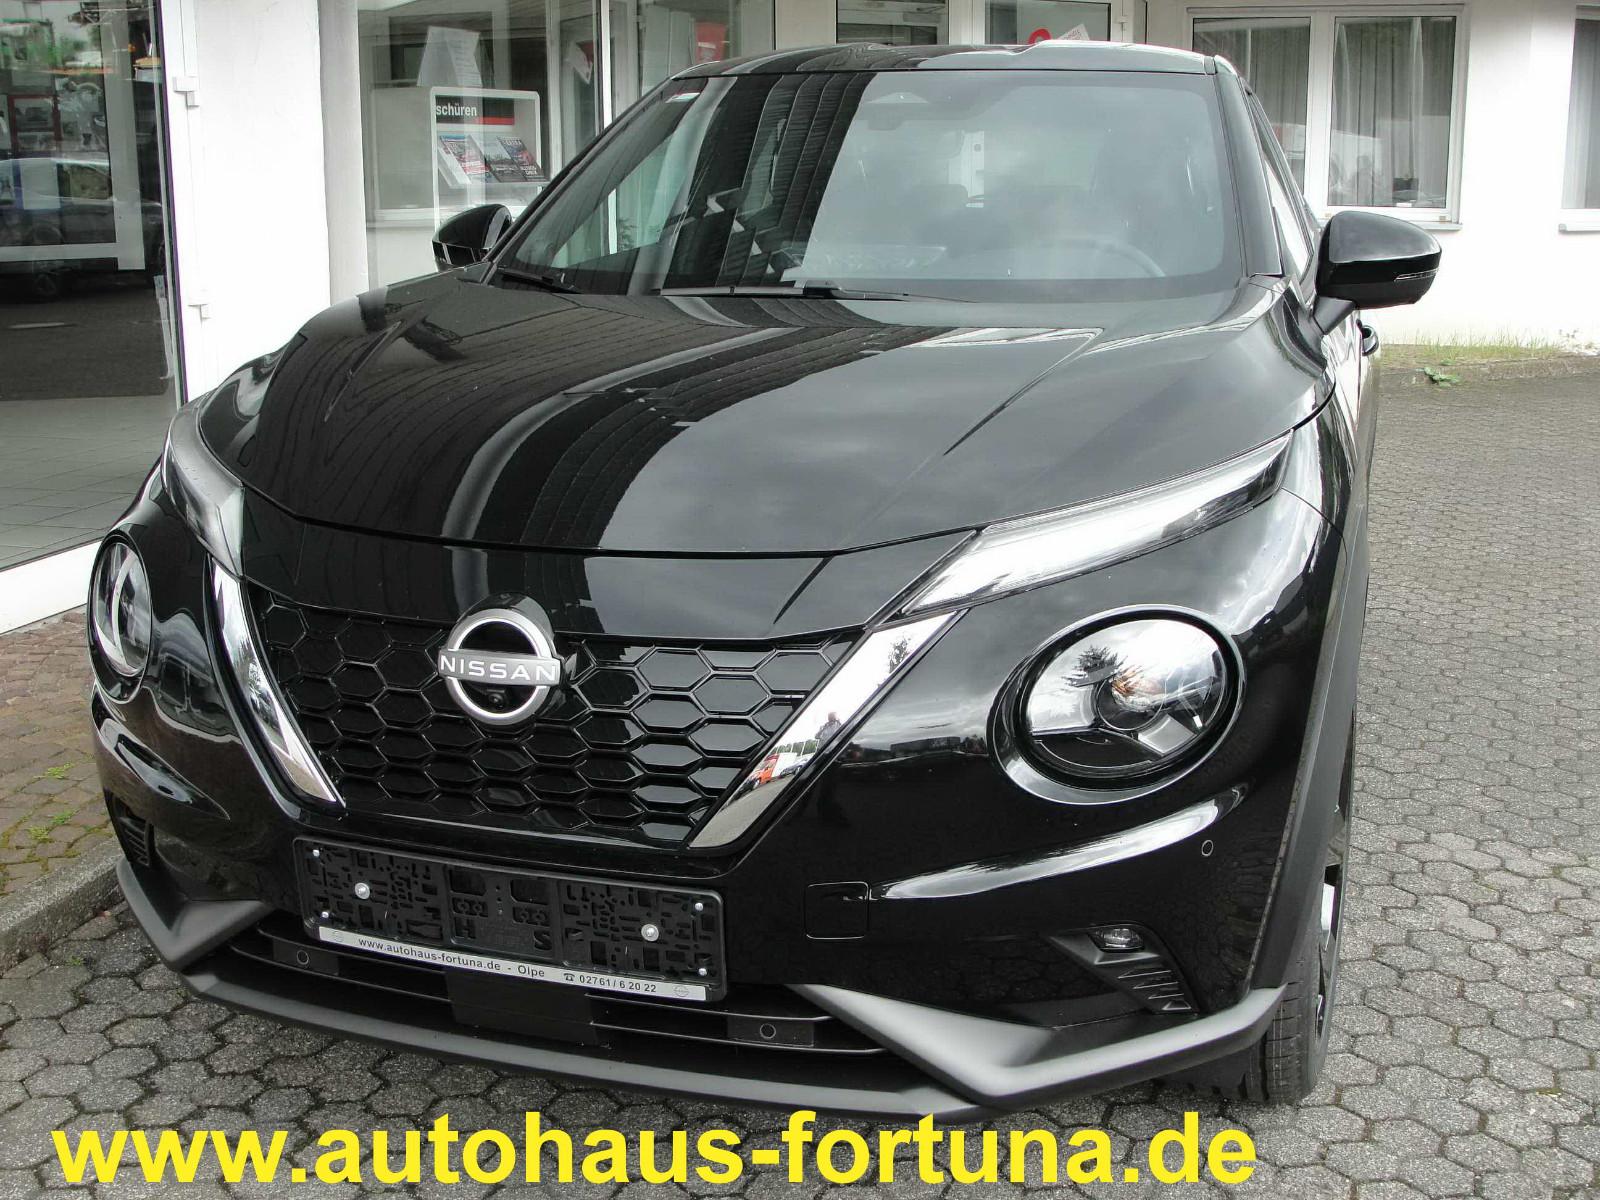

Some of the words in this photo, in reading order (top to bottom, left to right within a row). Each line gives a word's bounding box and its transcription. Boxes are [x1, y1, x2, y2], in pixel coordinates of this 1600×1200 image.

[436, 103, 477, 116] schüren
[440, 655, 556, 681] NISSAN
[358, 938, 501, 971] www.autohaus-fortuna.de
[517, 965, 545, 977] Olpe
